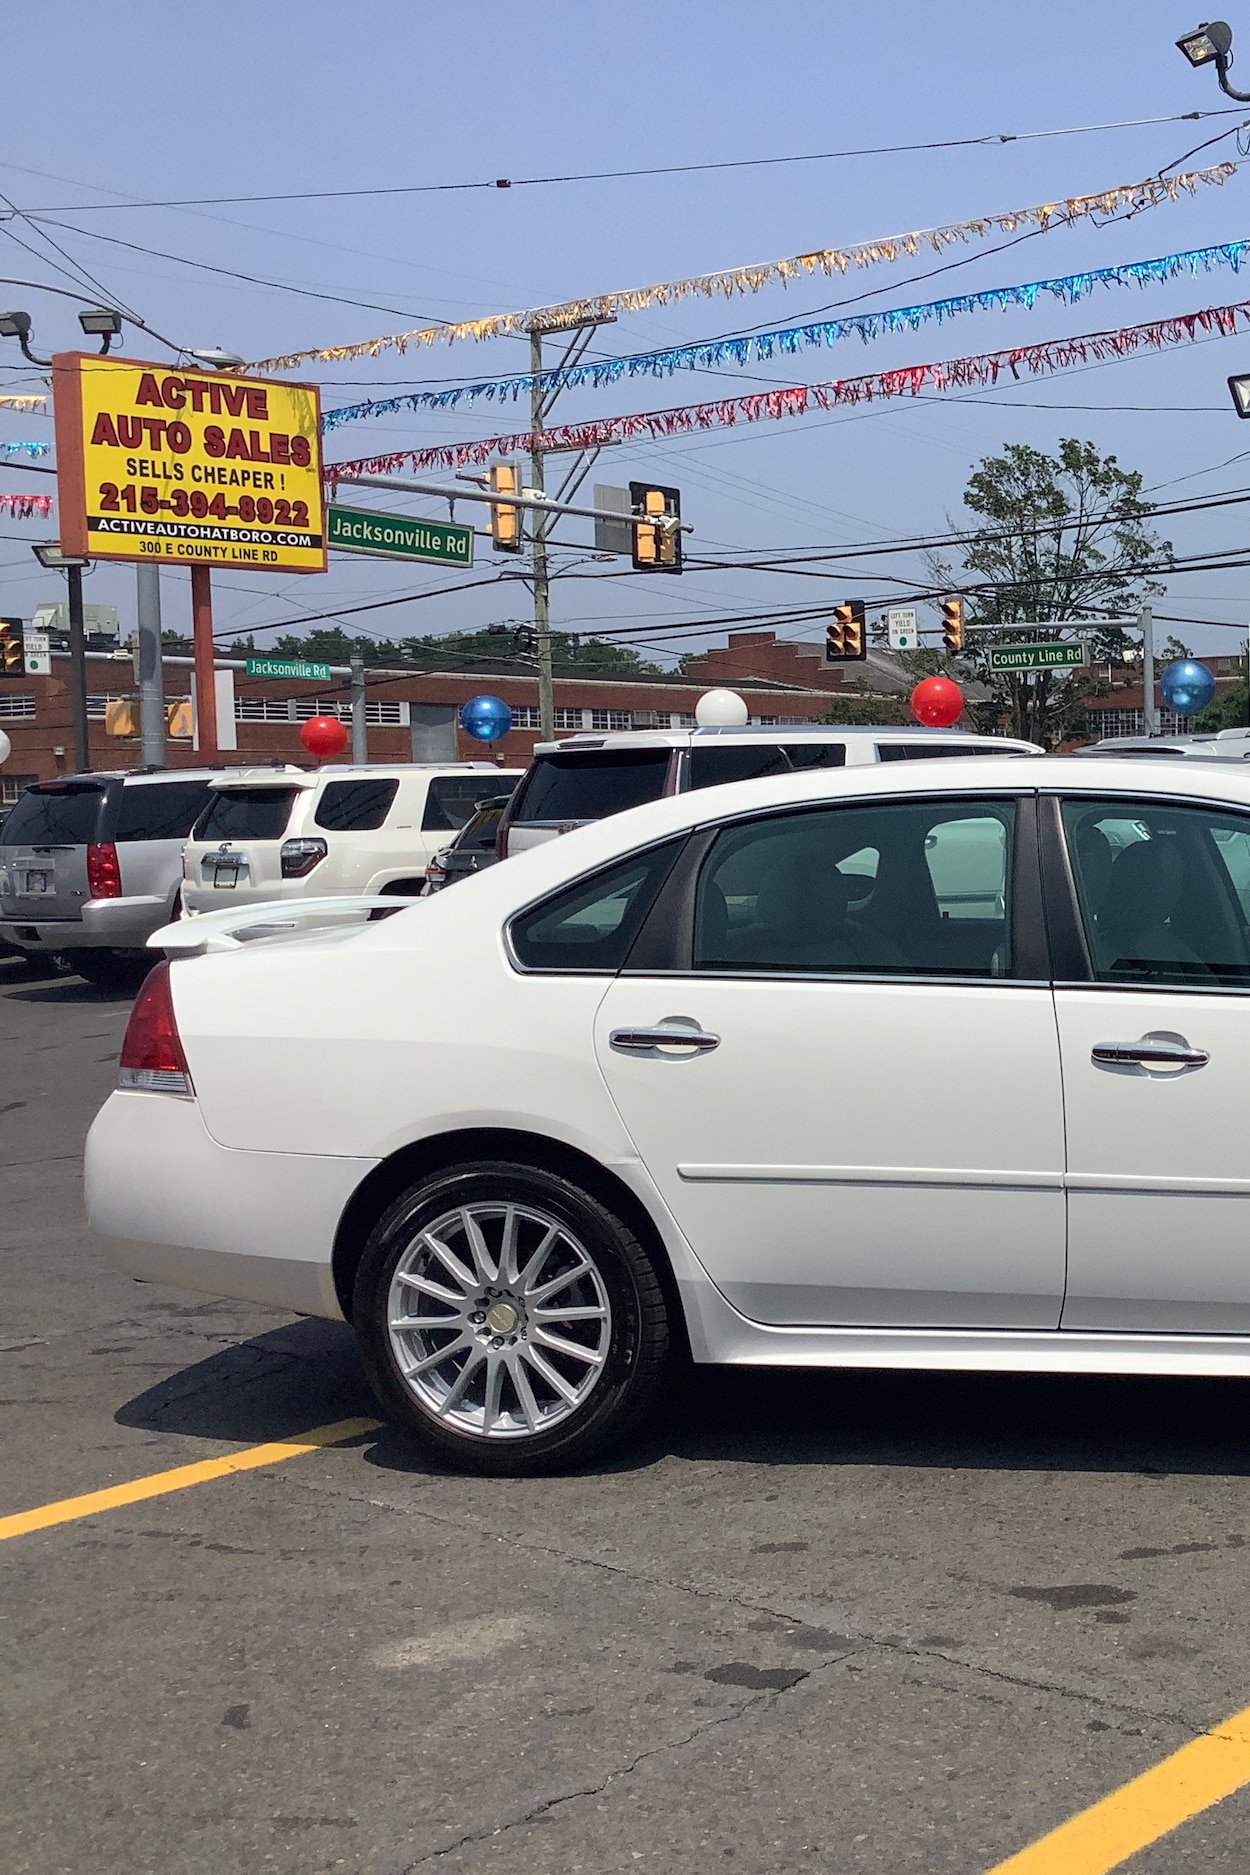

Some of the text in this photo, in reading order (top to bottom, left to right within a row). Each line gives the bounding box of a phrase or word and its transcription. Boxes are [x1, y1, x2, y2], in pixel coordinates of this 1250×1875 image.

[135, 373, 269, 420] ACTIVE
[91, 412, 312, 468] AUTO SALES
[126, 457, 185, 481] SELLS
[190, 464, 275, 490] CHEAPER
[99, 482, 310, 528] 215-394-8922
[97, 519, 312, 547] ACTIVEAUTOHATBORO.COM
[333, 518, 467, 555] Jacksonville Rd
[139, 541, 278, 562] 300 E COUNTY LINE RD
[894, 619, 911, 628] YIELD
[250, 660, 327, 678] Jacksonville Rd
[993, 647, 1081, 666] County Line Rd
